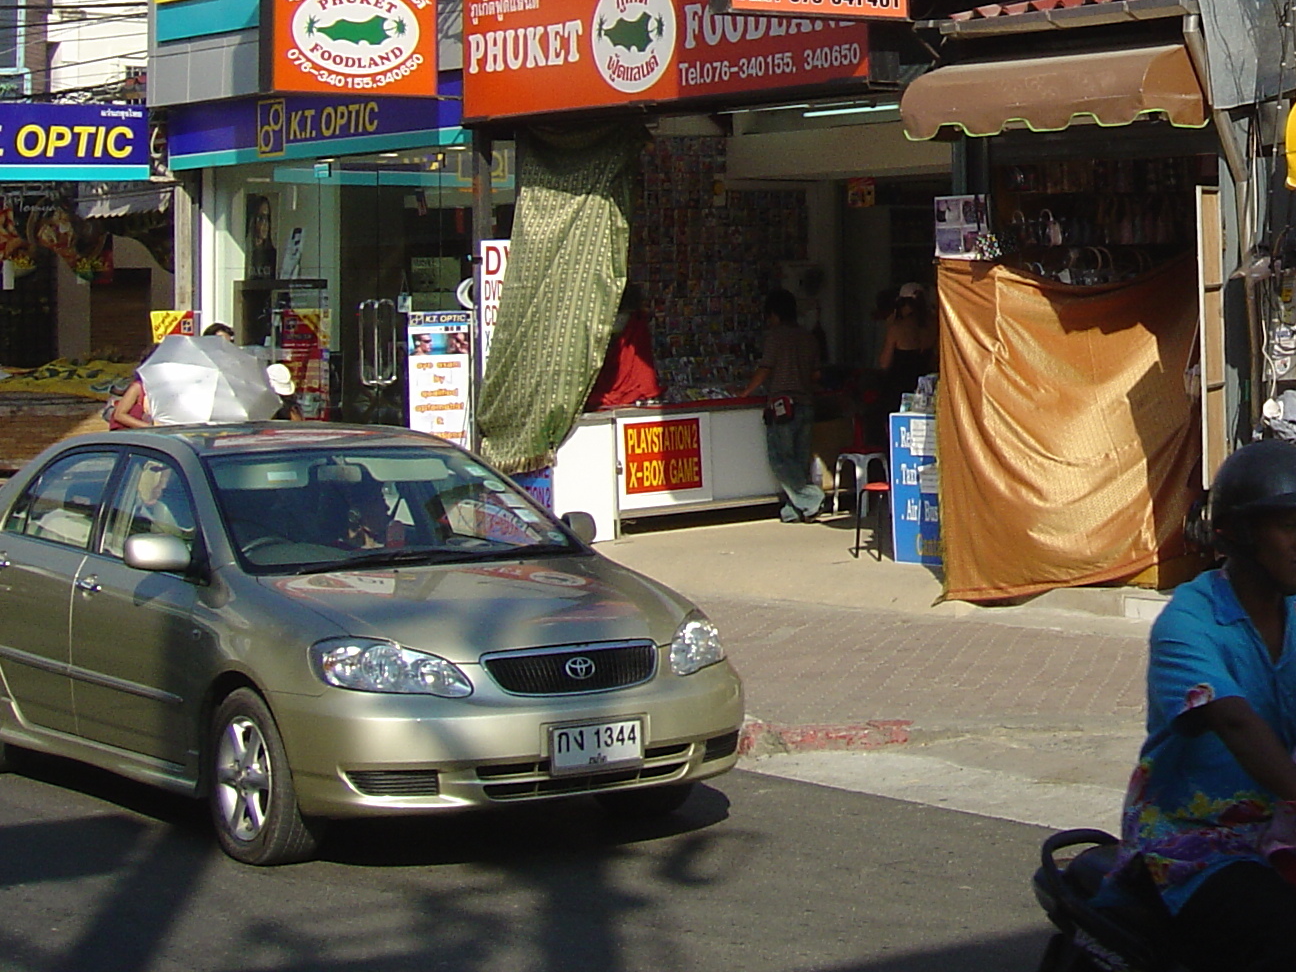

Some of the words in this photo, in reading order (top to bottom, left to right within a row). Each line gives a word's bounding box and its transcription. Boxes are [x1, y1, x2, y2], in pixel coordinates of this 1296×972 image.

[309, 43, 404, 69] FOODLAND
[469, 19, 583, 74] PHUKET
[804, 43, 860, 71] 340650
[290, 110, 316, 140] K.T.
[321, 101, 379, 137] OPTIC
[16, 125, 134, 158] OPTIC
[425, 315, 438, 323] K.T.
[440, 314, 466, 323] OPTIC
[628, 425, 690, 454] PLAYSTATION
[692, 424, 698, 448] 2
[629, 459, 666, 488] X-BOX
[670, 458, 699, 484] GAME
[594, 724, 636, 749] 1344
